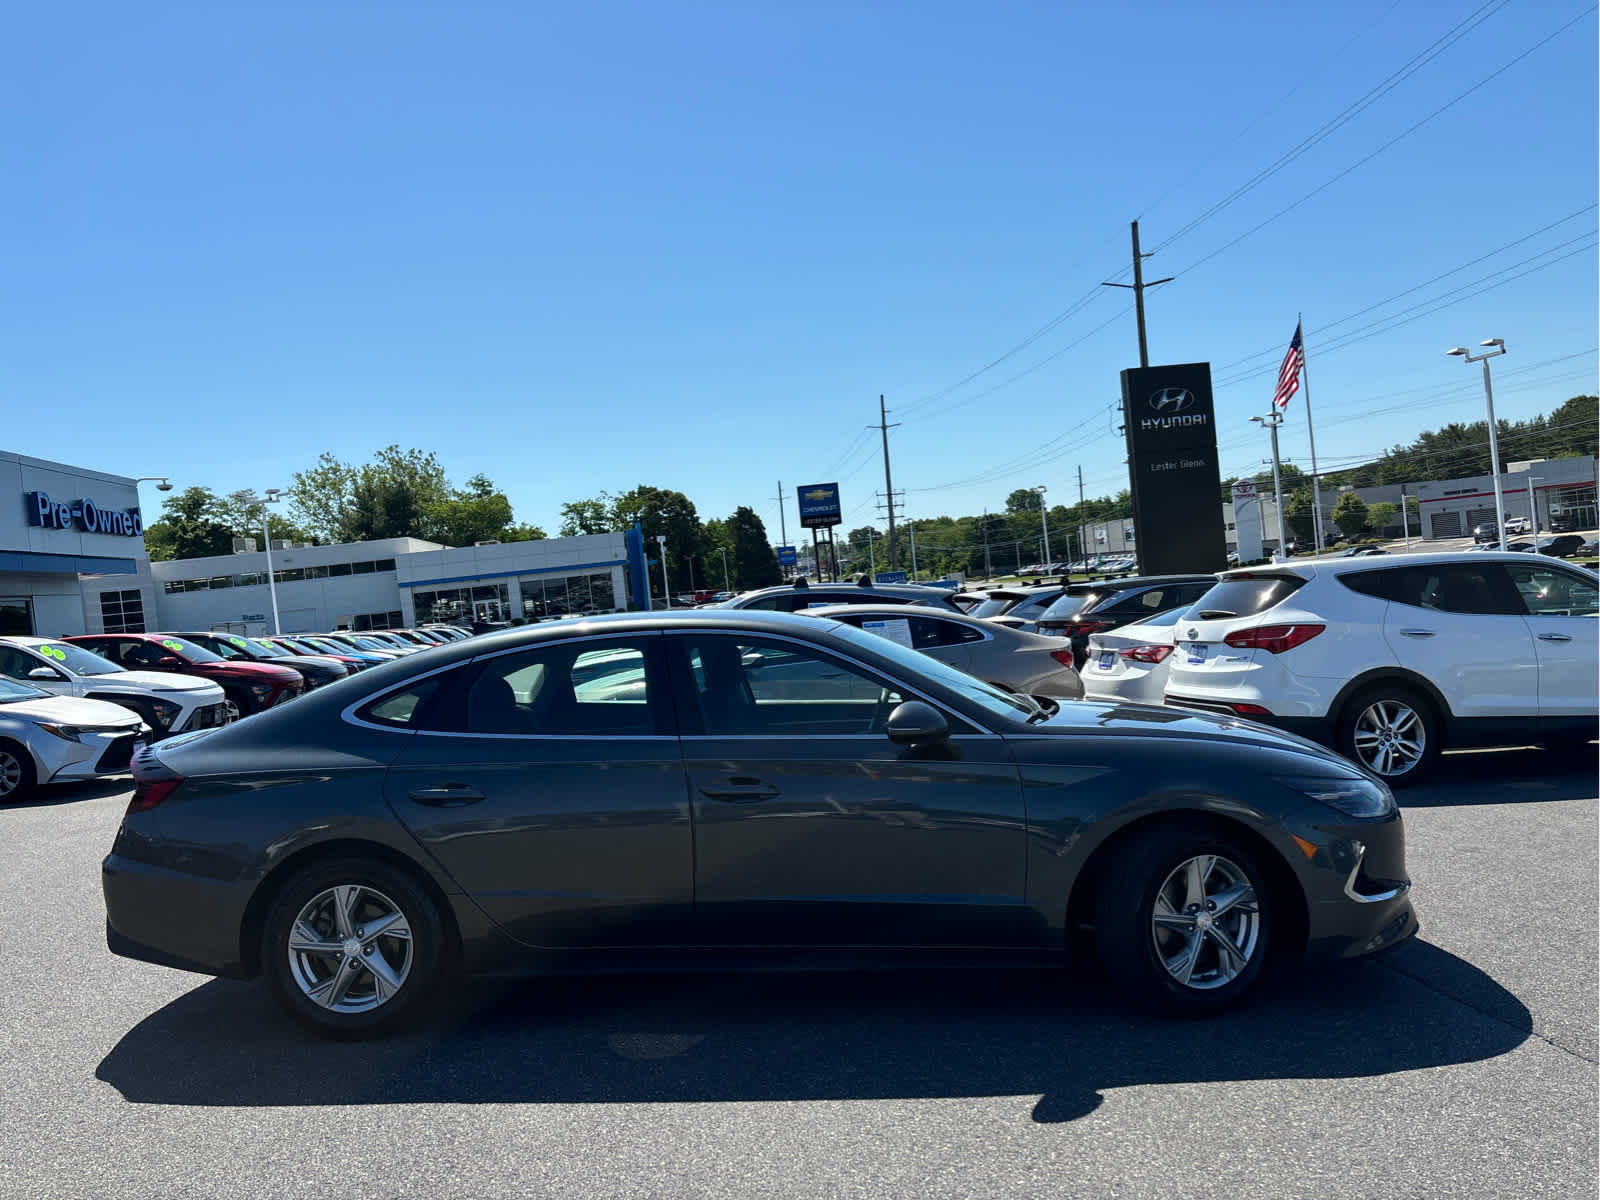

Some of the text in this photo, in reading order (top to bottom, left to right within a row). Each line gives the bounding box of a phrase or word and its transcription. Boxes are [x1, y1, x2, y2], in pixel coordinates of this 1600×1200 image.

[1141, 414, 1207, 430] HYUNDAI
[1151, 459, 1205, 471] Lester Glenn
[35, 491, 143, 536] Pre-Owned
